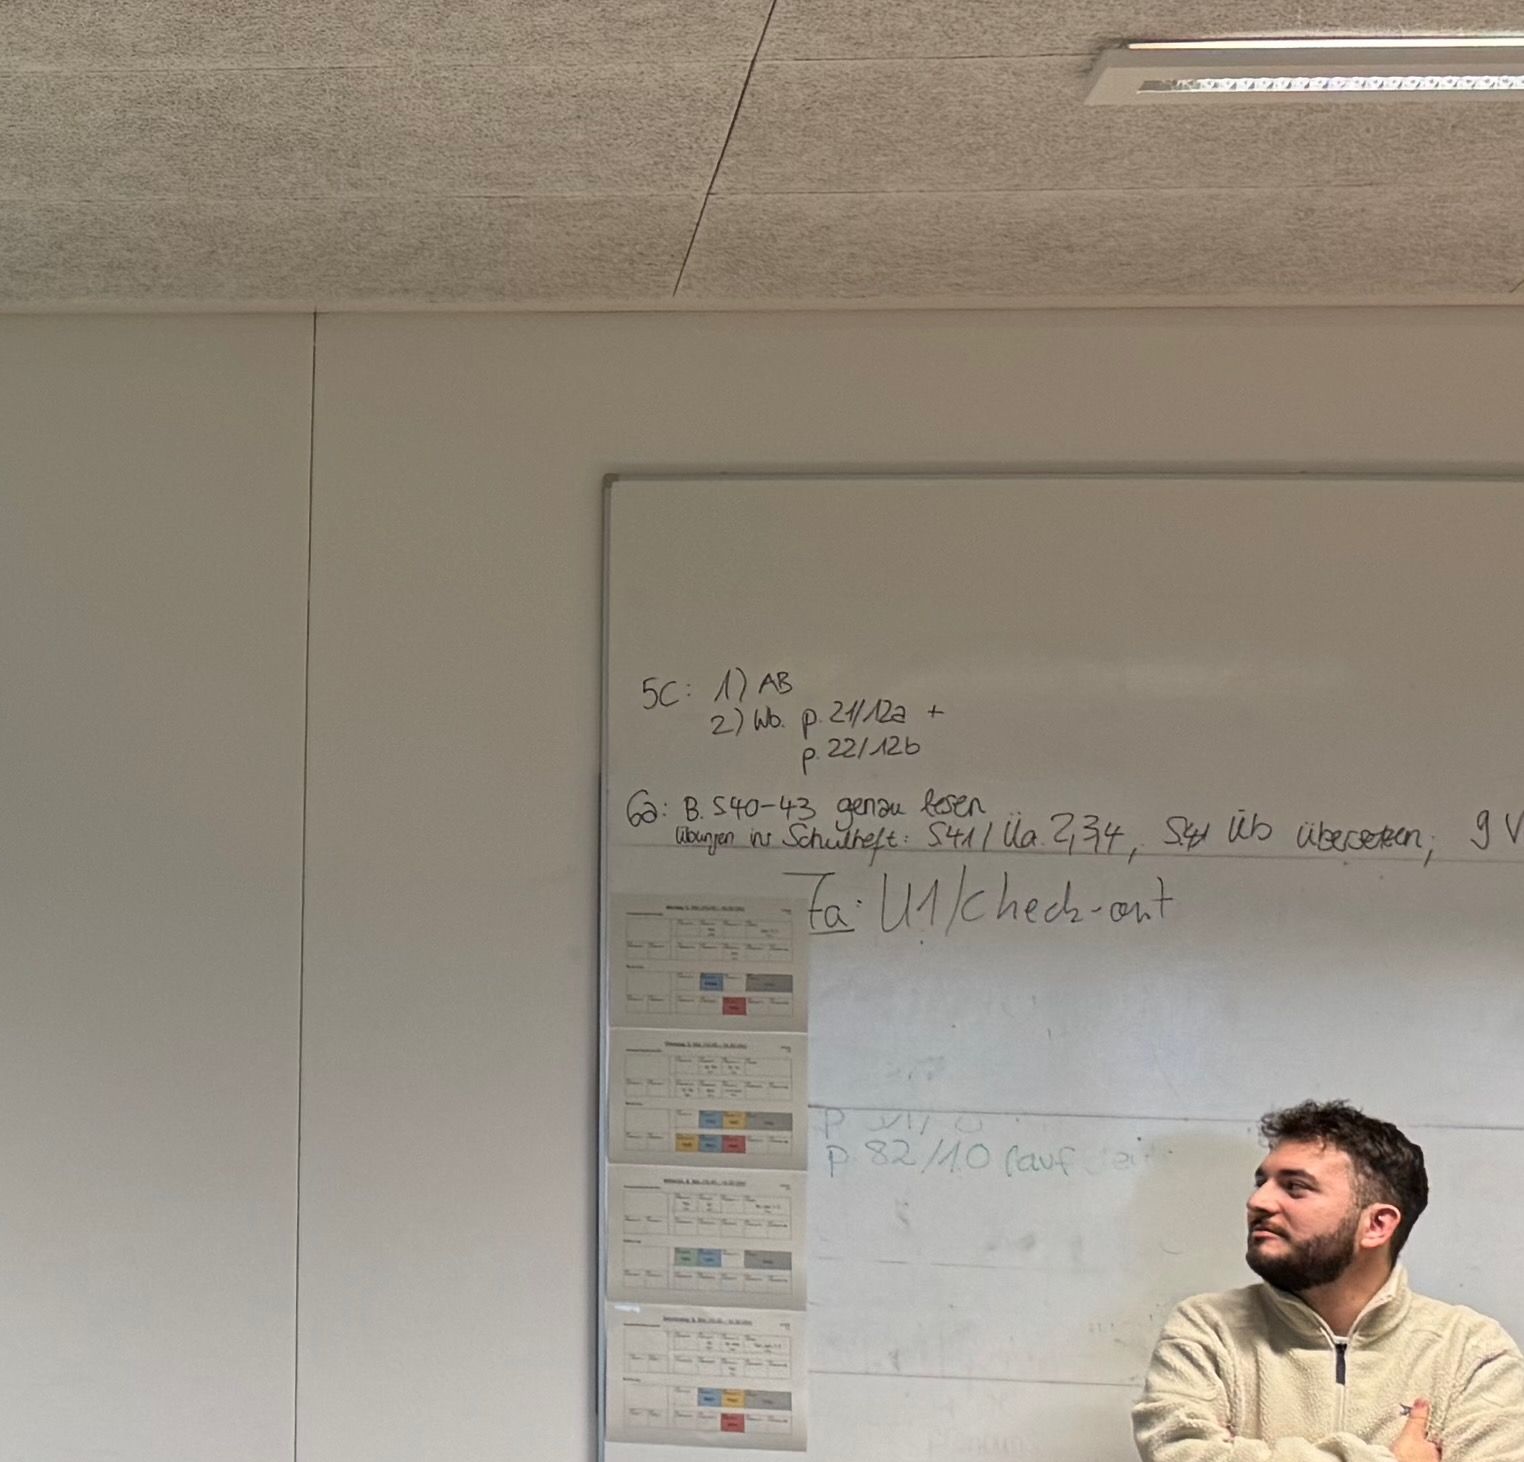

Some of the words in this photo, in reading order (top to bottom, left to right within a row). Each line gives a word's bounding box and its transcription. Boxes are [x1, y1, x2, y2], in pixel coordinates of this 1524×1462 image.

[714, 667, 748, 702] 1)
[758, 671, 793, 695] AB
[712, 706, 744, 737] 2)
[835, 796, 906, 831] genau
[920, 788, 986, 815] lesen
